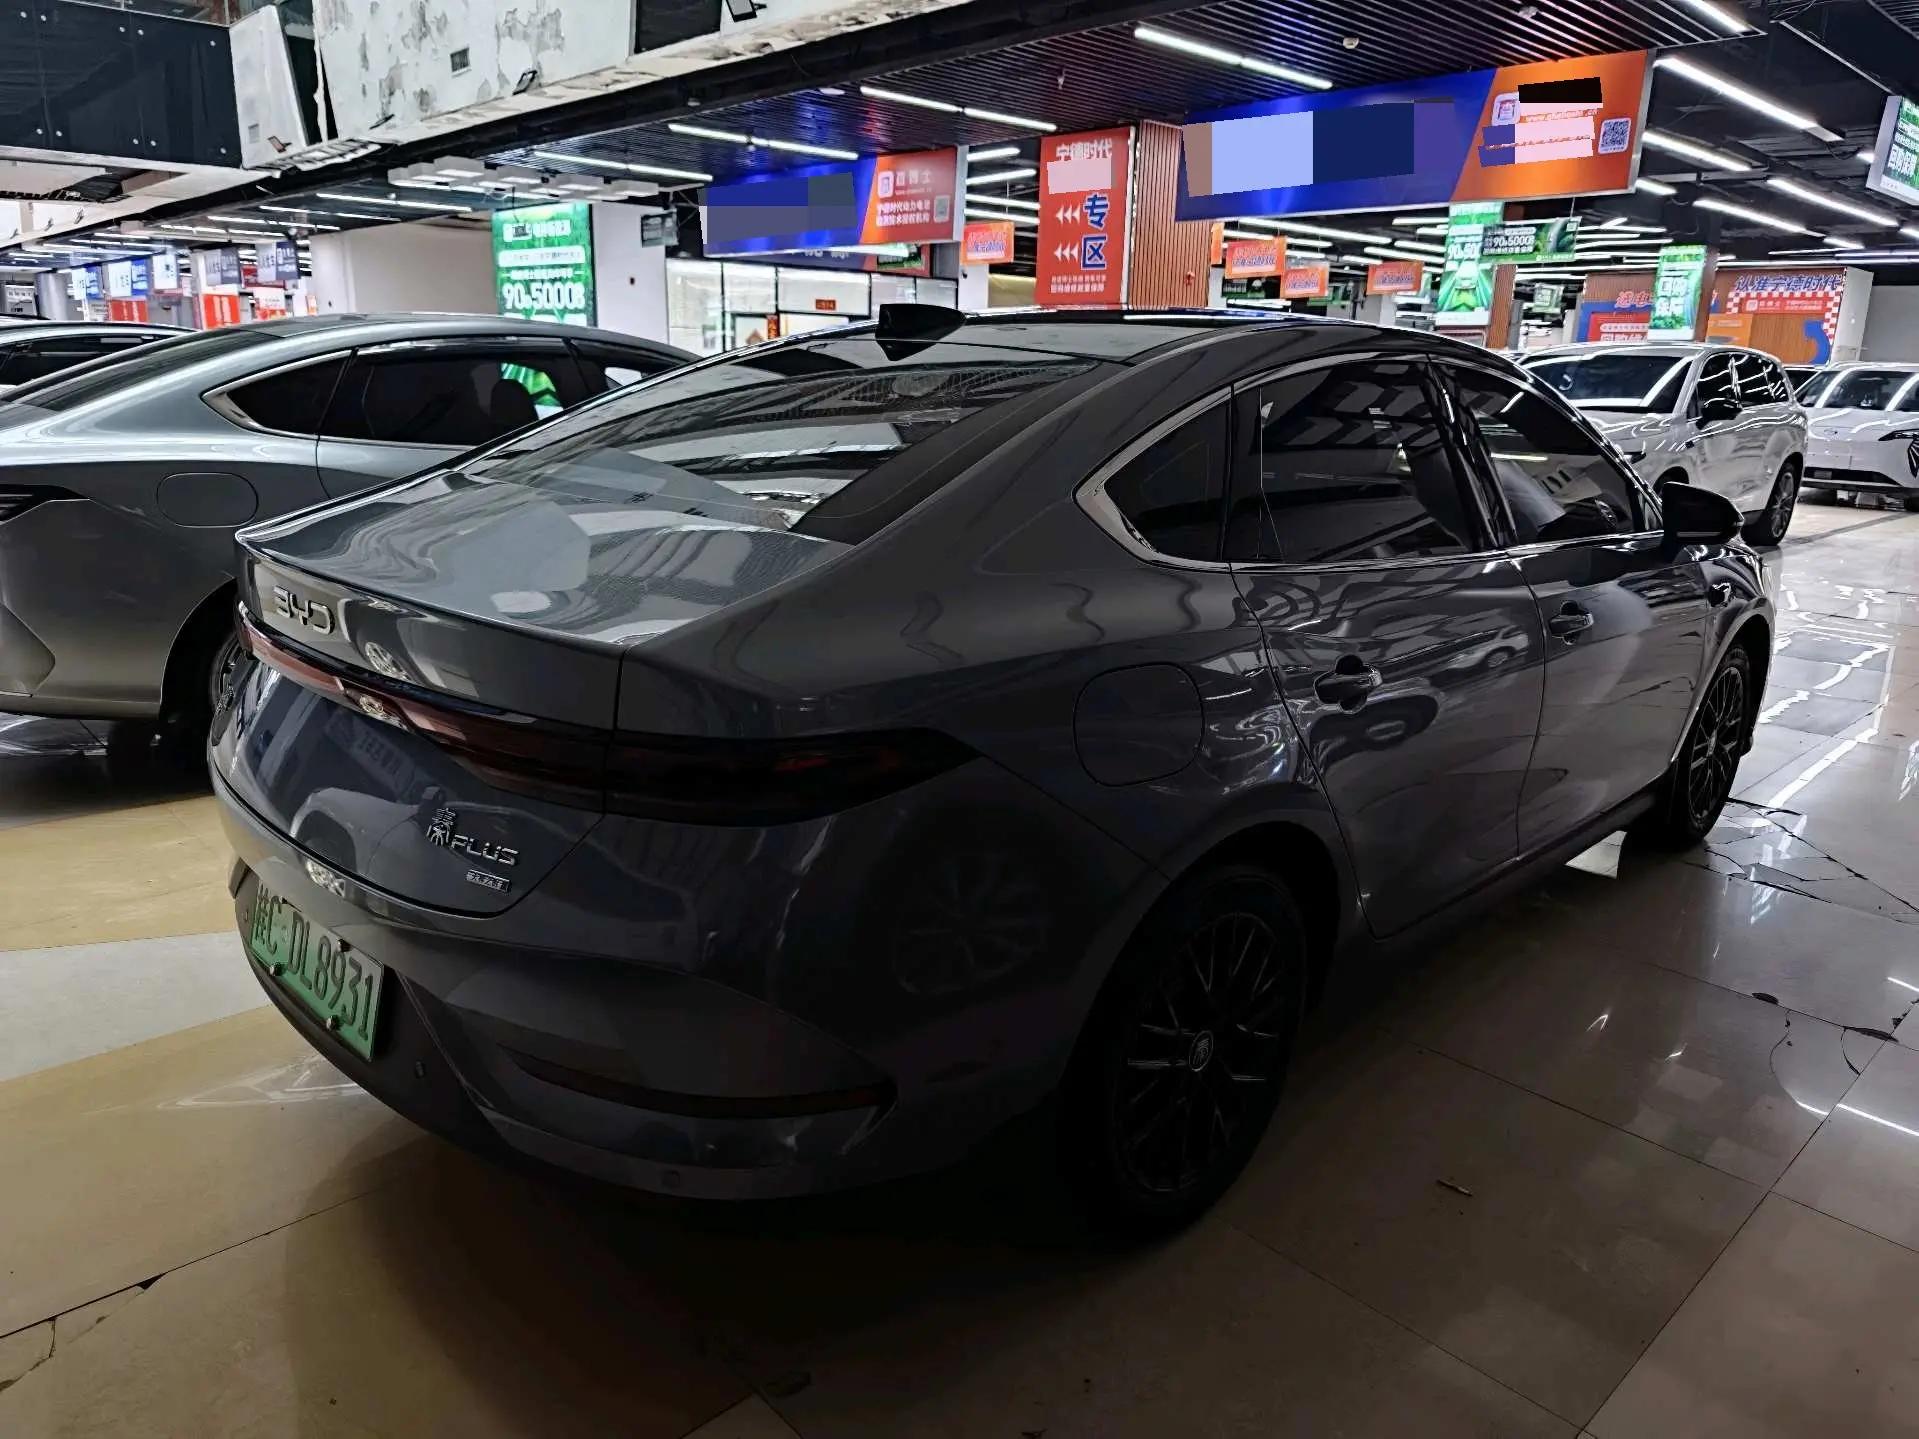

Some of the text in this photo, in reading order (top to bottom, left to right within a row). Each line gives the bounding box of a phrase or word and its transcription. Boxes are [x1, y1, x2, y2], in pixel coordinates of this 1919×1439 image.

[1081, 192, 1110, 270] 专区
[1736, 274, 1841, 292] 认准宁德时代
[274, 586, 334, 634] BYD
